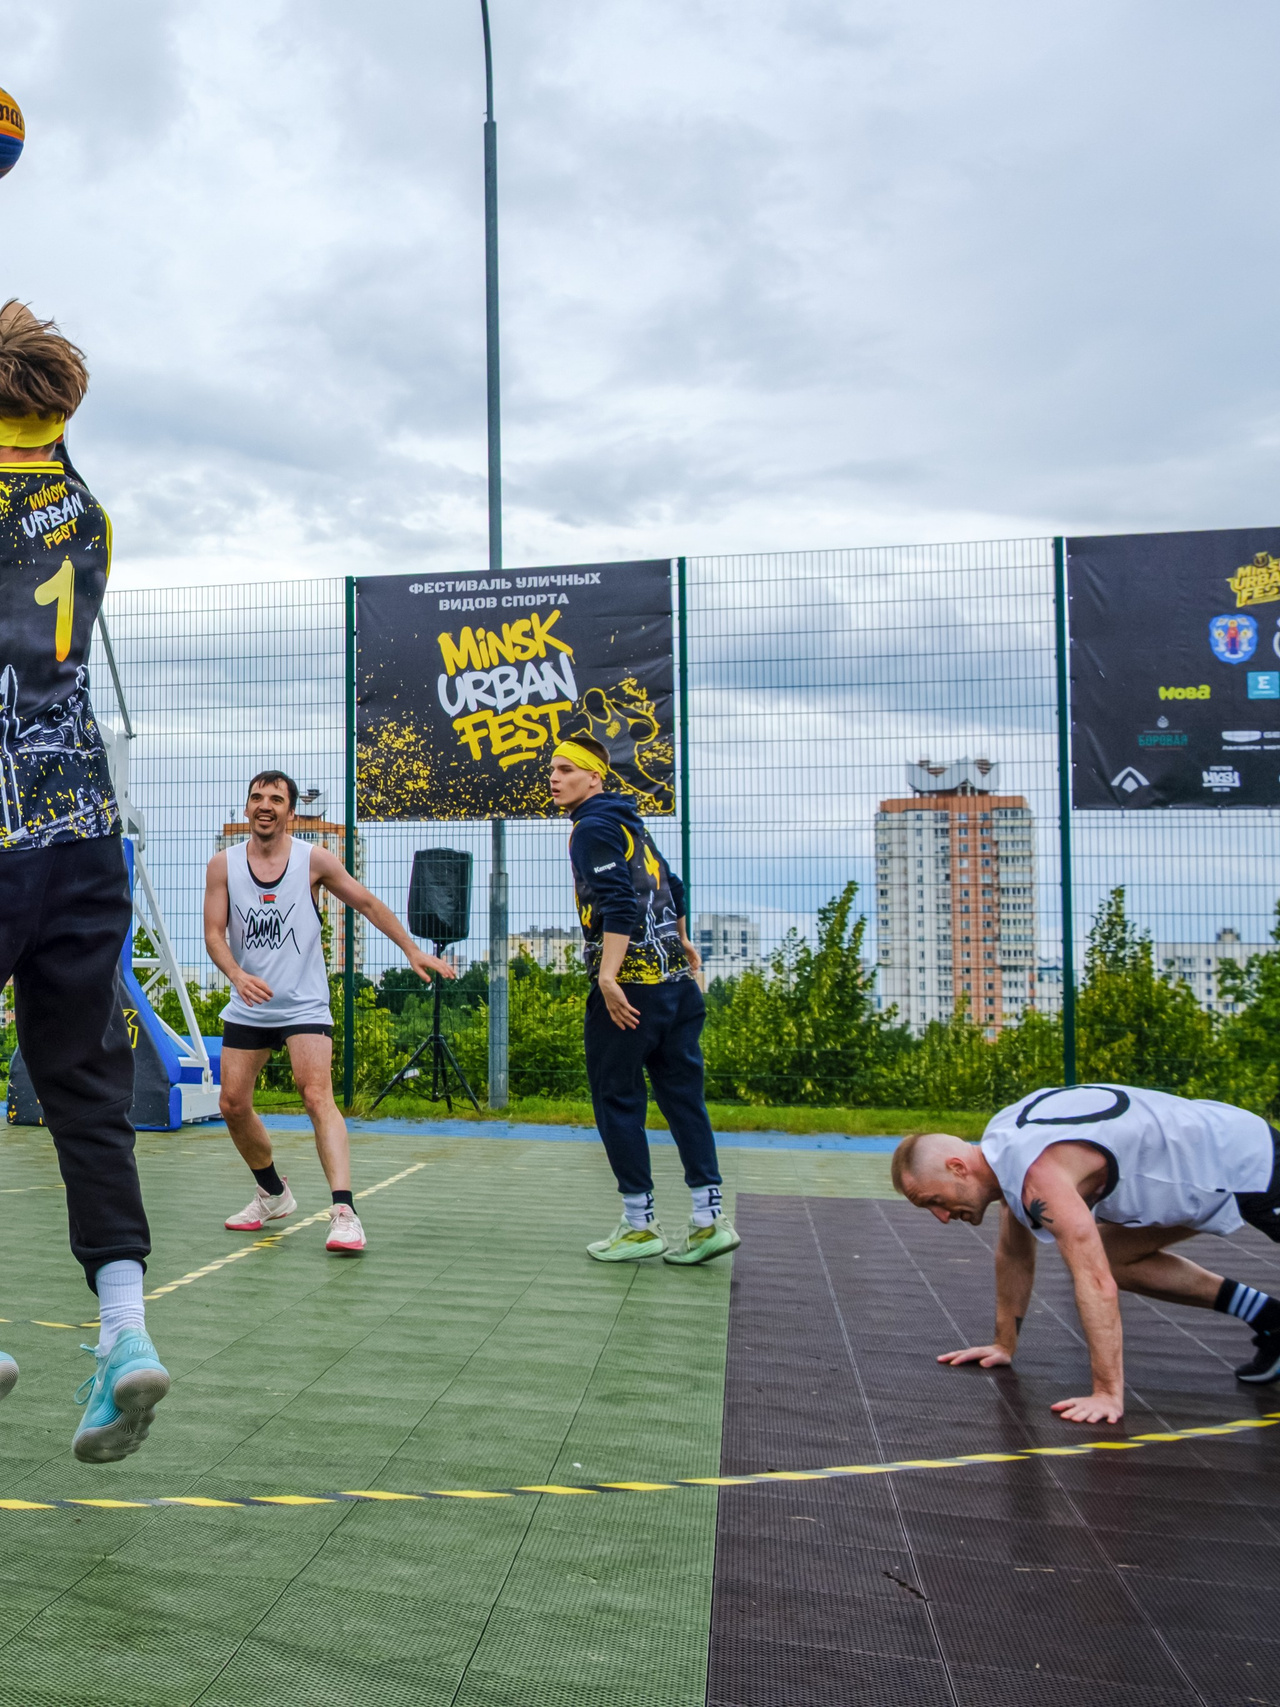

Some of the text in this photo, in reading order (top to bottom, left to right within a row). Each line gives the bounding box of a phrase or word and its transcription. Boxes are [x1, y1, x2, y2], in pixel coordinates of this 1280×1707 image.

[21, 492, 85, 538] URBAN
[42, 517, 78, 549] FEST
[1236, 561, 1280, 578] MINS
[408, 572, 602, 594] ФЕСТИВАЛЬ УЛИЧНЫХ
[1234, 571, 1280, 591] URBA
[438, 593, 570, 611] ВИДОВ СПОРТА
[1240, 583, 1280, 602] FES
[34, 560, 75, 662] 1
[437, 651, 579, 718] URBAN
[452, 700, 573, 761] FEST
[594, 861, 616, 873] Kempa
[128, 1341, 155, 1355] NIK
